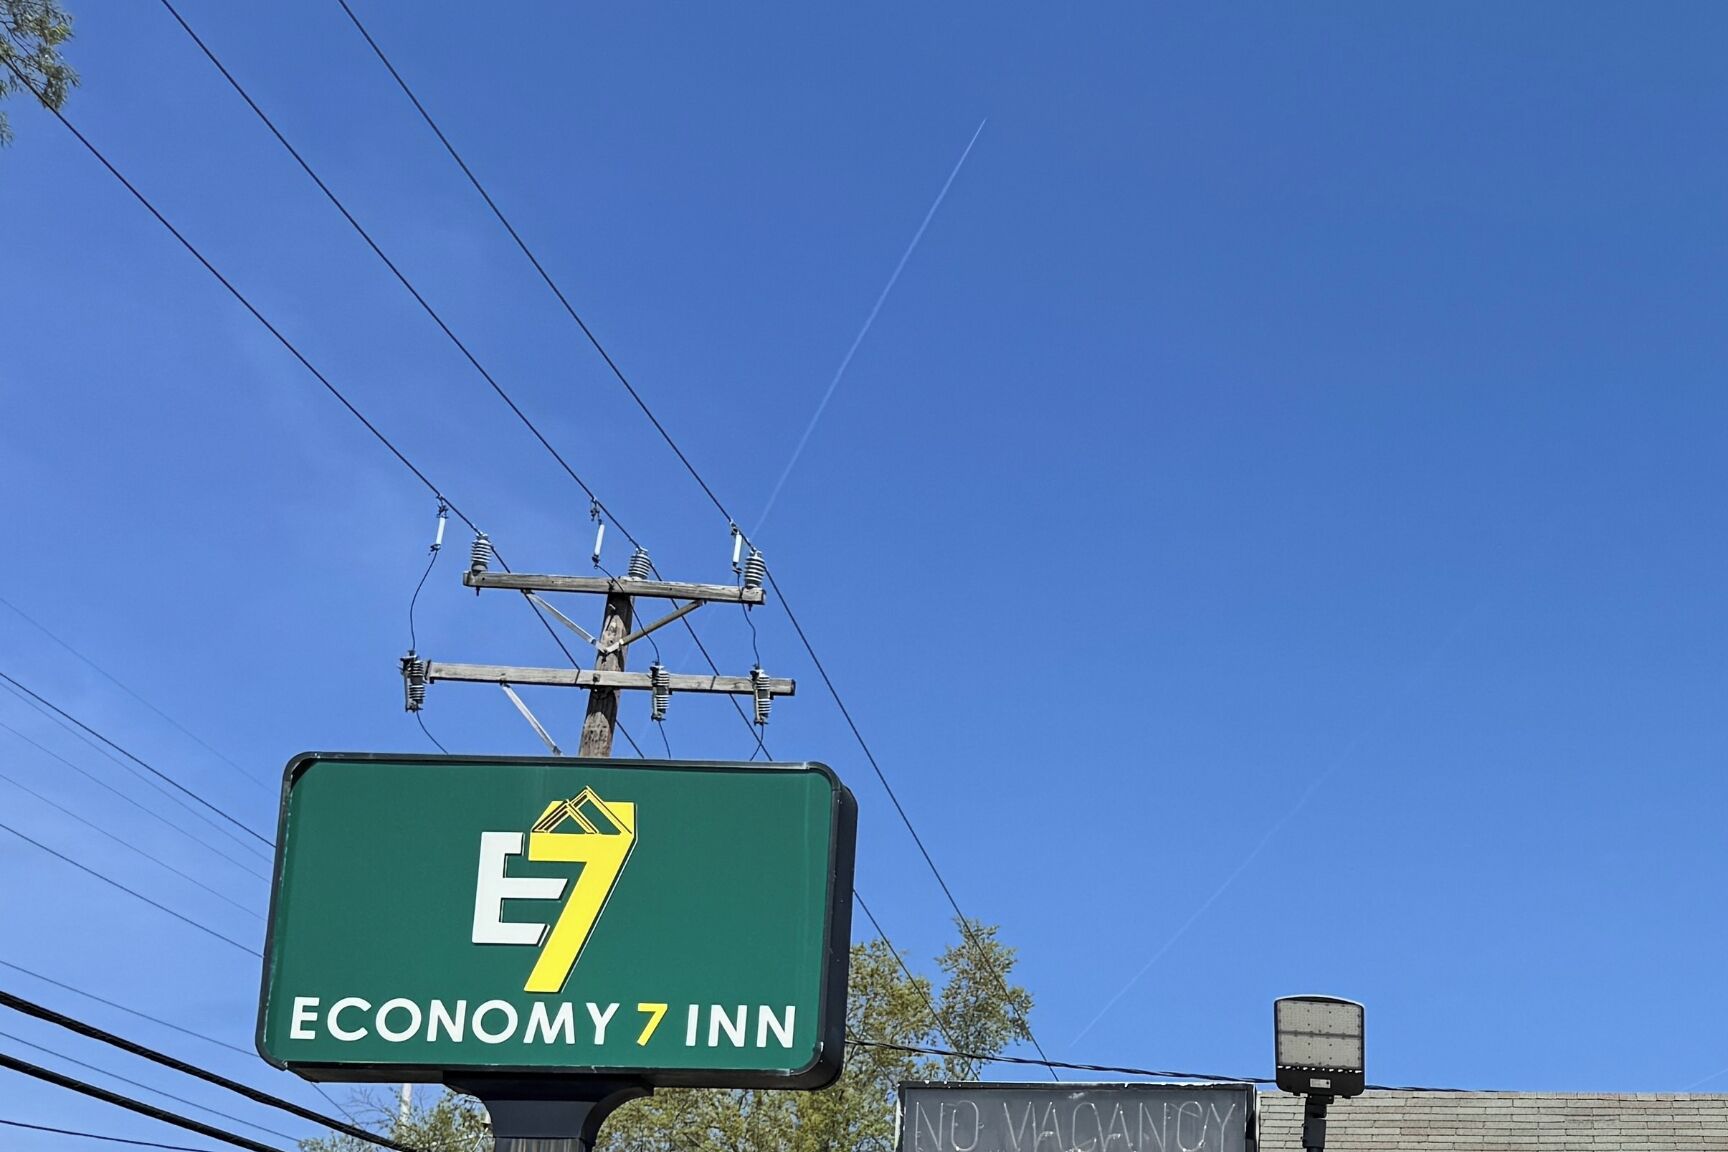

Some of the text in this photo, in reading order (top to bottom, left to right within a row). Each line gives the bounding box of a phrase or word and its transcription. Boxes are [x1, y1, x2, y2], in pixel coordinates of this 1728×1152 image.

[290, 996, 797, 1049] ECONOMY 7 INN
